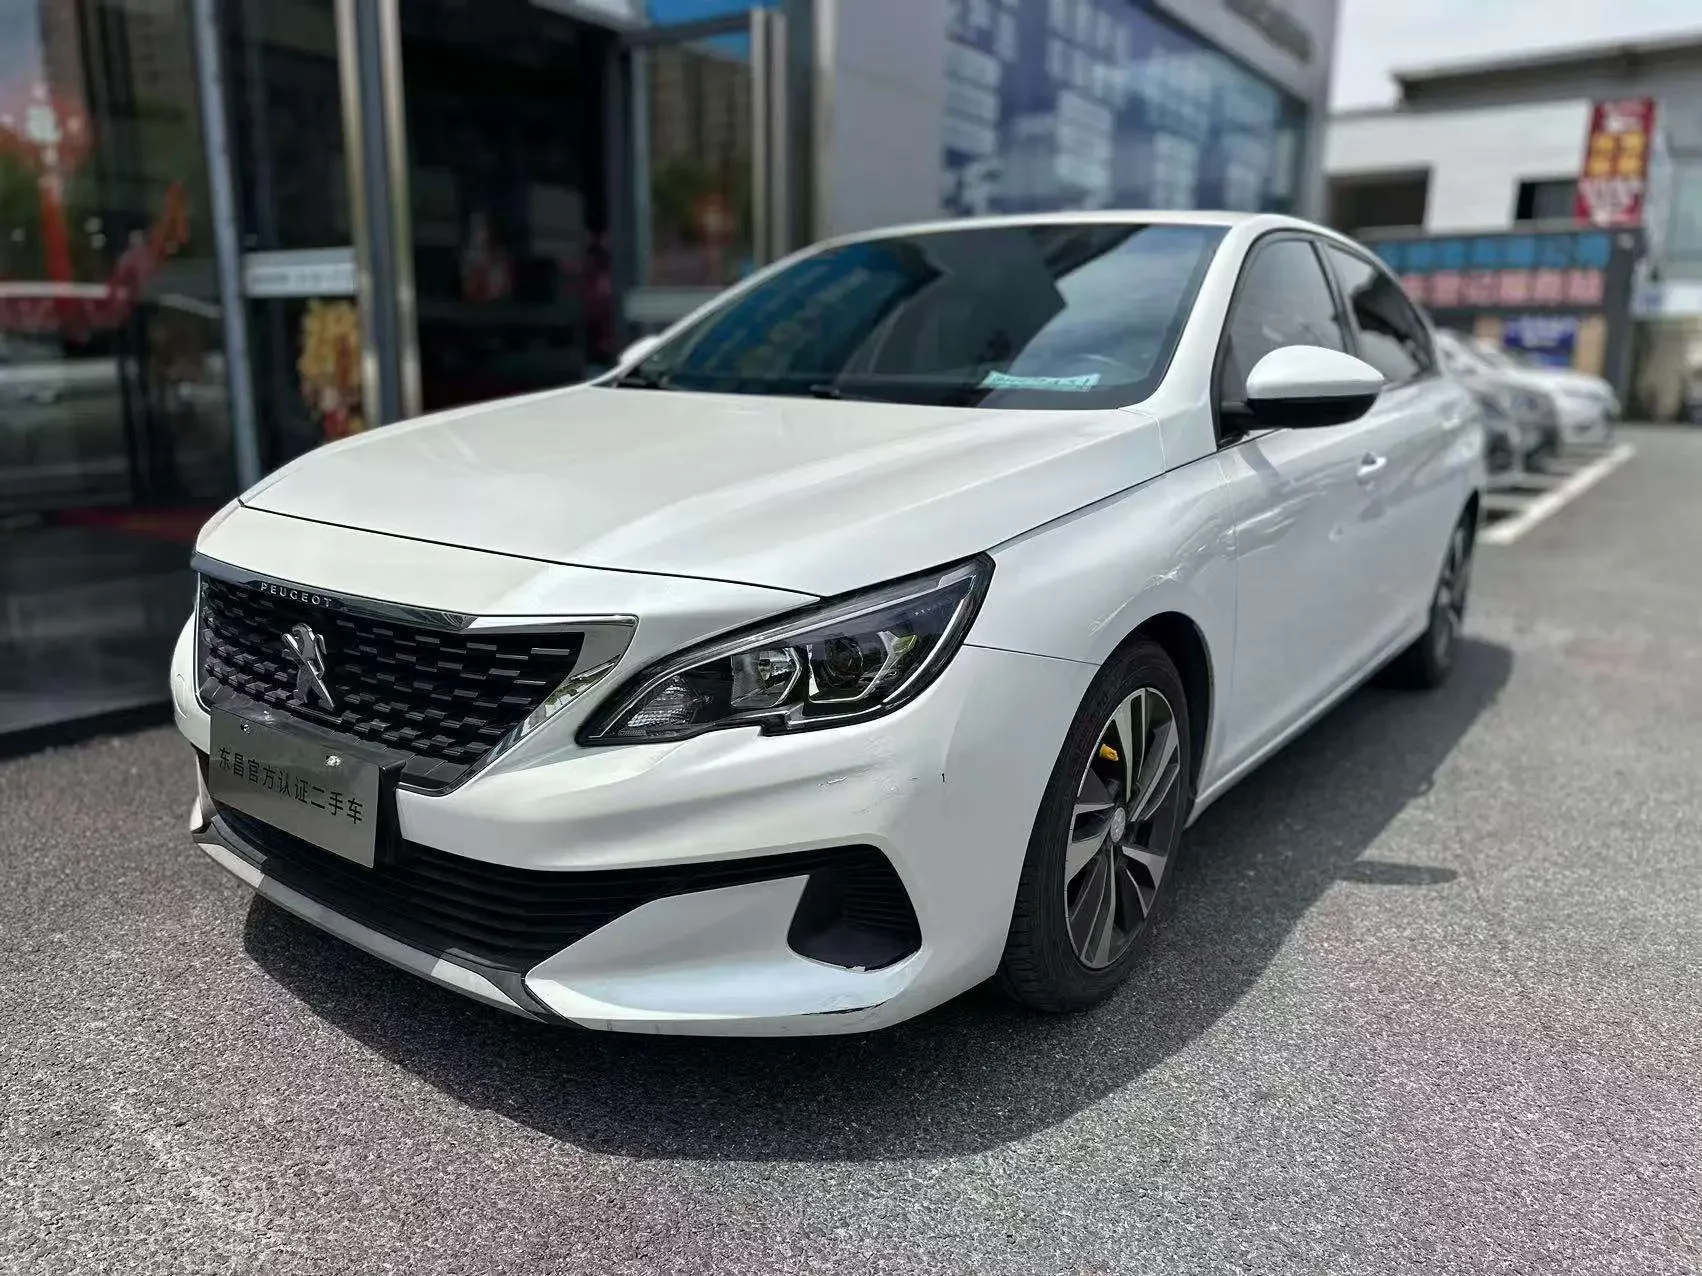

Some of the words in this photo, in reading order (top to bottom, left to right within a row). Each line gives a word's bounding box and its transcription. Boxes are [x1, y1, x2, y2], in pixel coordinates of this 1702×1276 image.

[260, 582, 332, 608] PEUGEOT
[218, 747, 363, 825] 东昌官方认证二手车
